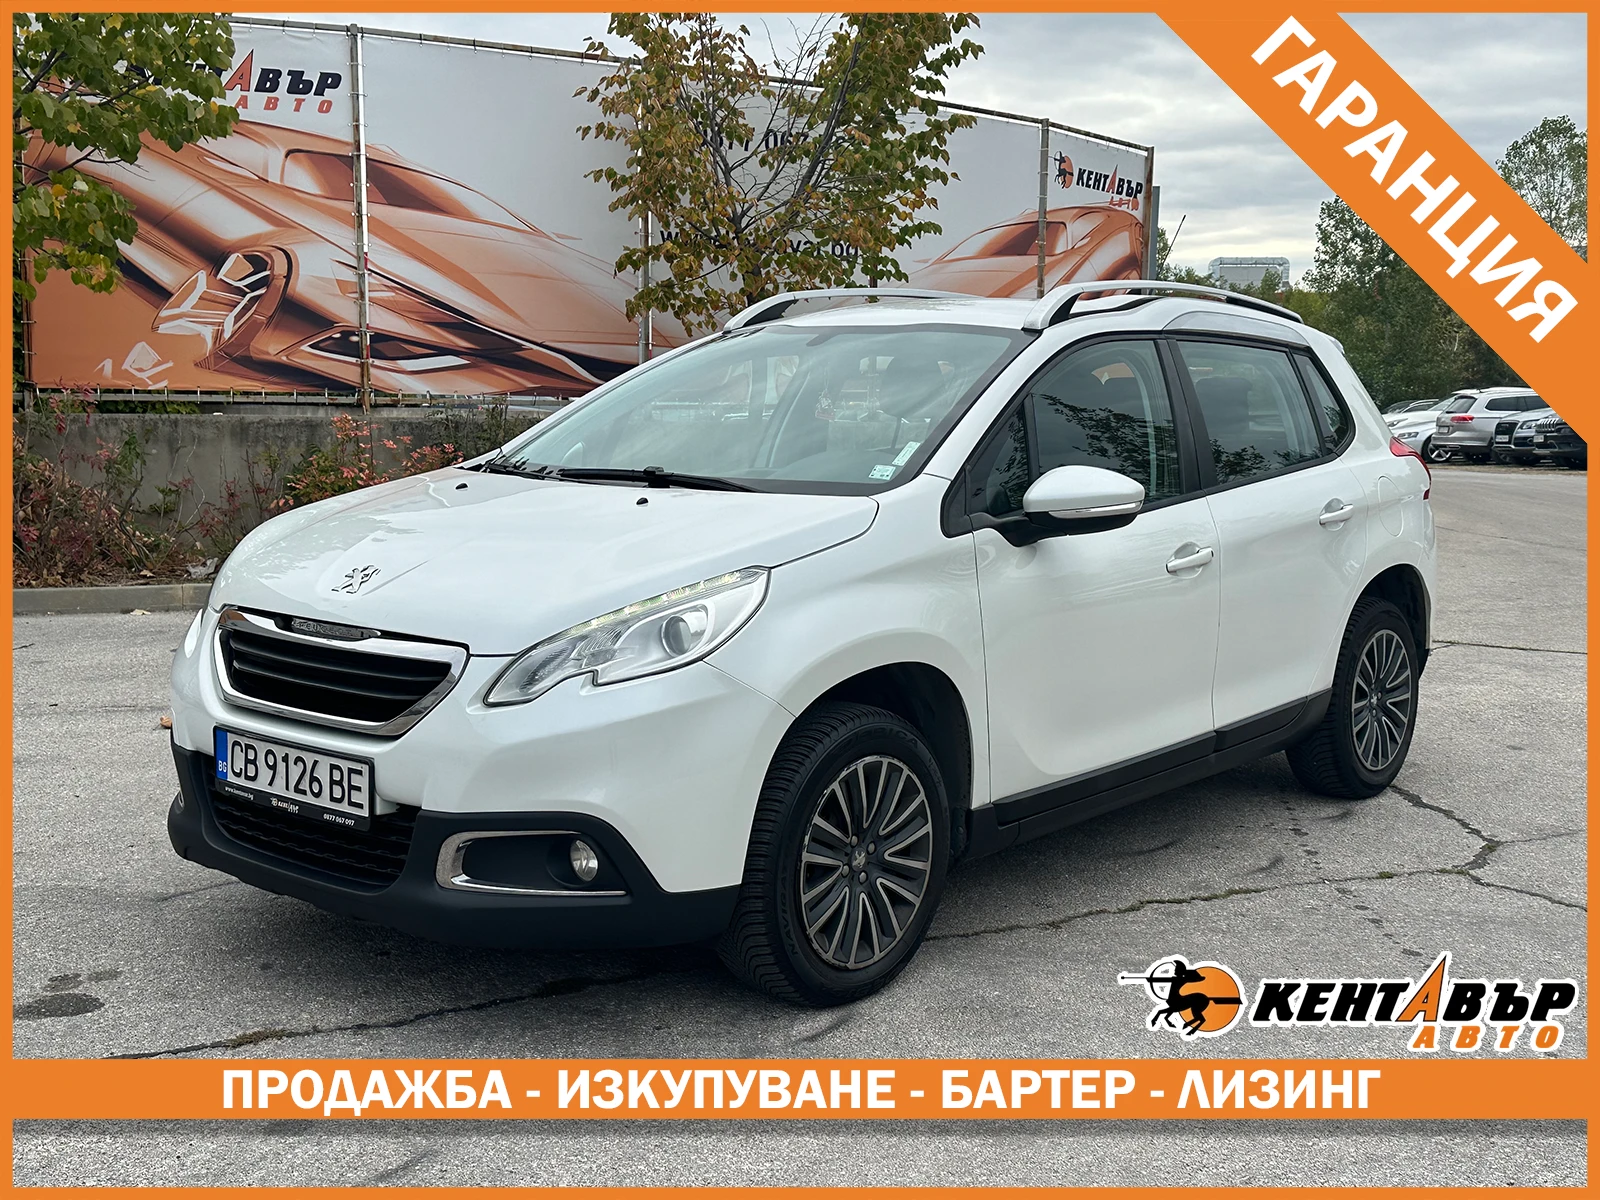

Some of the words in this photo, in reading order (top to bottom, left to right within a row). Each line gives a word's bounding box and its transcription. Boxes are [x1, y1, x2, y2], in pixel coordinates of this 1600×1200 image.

[124, 49, 342, 97] АВЪР
[233, 95, 333, 114] АВТО
[1076, 164, 1144, 199] КЕНТАВЪР
[218, 760, 227, 773] BG
[264, 748, 323, 799] 9126
